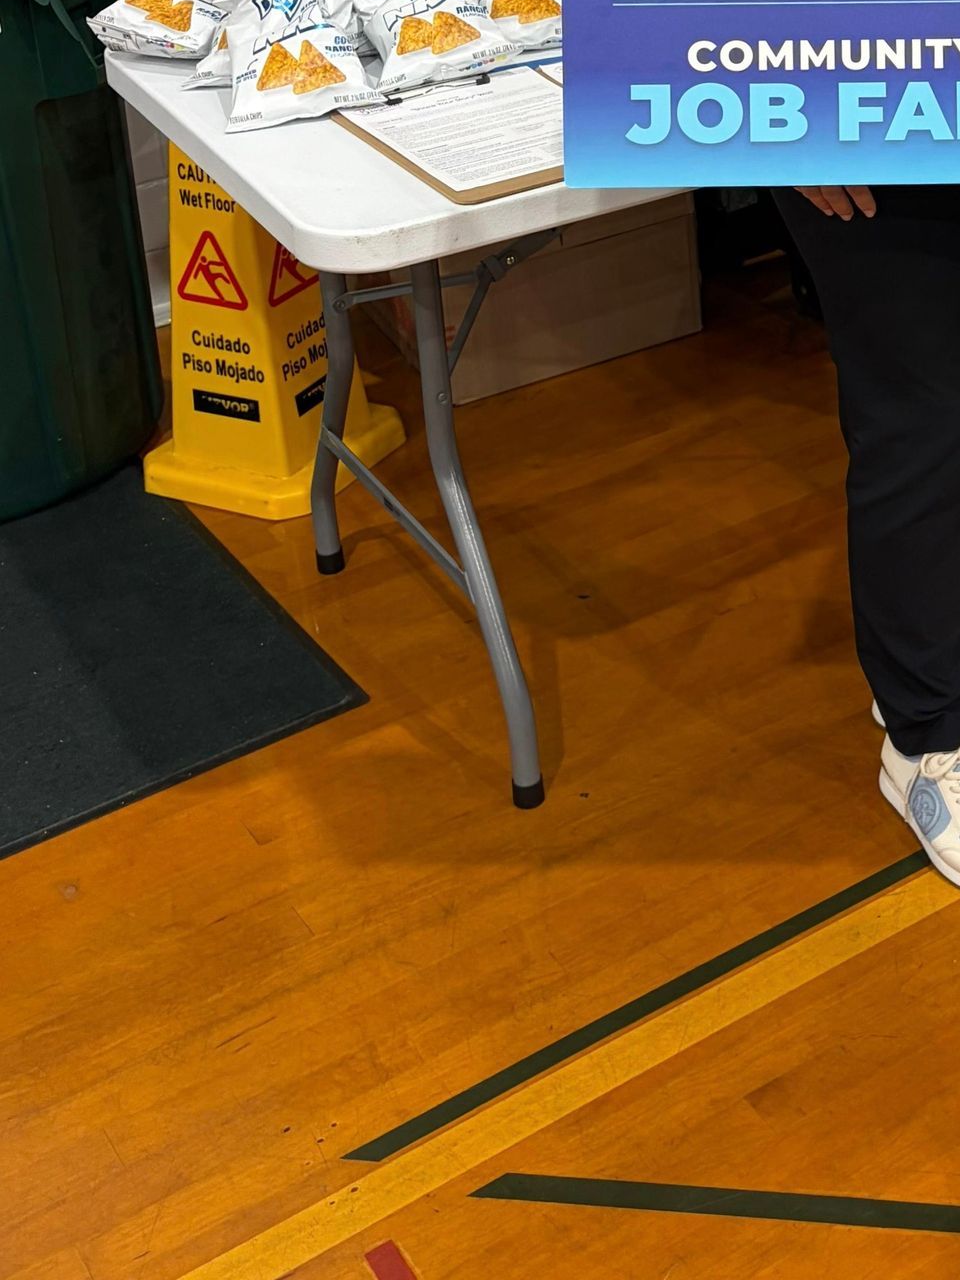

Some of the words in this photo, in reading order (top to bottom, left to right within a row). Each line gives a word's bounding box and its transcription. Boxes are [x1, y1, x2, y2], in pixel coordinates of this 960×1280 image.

[625, 81, 810, 145] JOB
[179, 188, 203, 208] Wet
[204, 192, 237, 213] Floor
[191, 330, 250, 355] Cuidado
[182, 353, 212, 374] Piso
[216, 360, 265, 383] Mojado
[282, 355, 307, 382] Piso
